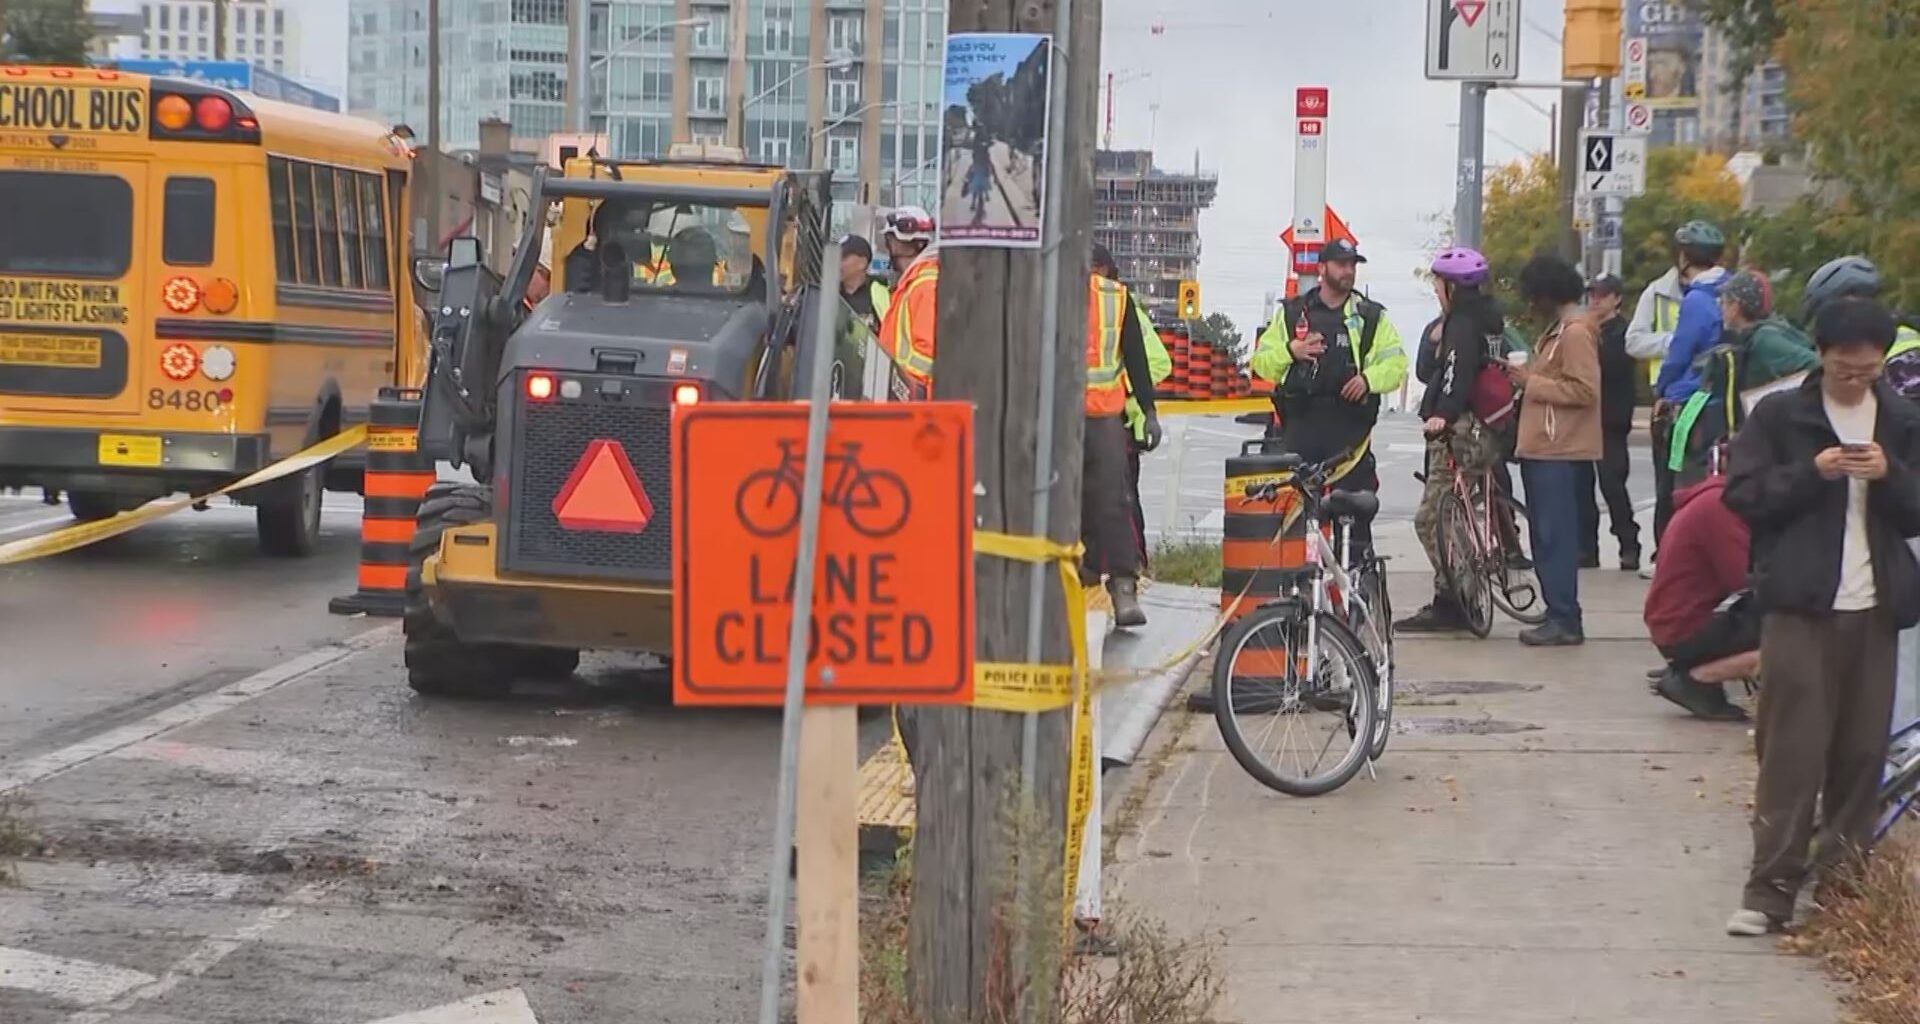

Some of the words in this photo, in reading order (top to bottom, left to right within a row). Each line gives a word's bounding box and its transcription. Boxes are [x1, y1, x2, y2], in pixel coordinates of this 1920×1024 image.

[89, 88, 142, 132] BUS
[1302, 122, 1319, 133] 149
[0, 279, 16, 298] DO
[20, 280, 42, 300] NOT
[46, 281, 79, 302] PASS
[82, 284, 119, 304] WHEN
[16, 301, 61, 321] LIGHTS
[64, 303, 129, 324] FLASHING
[148, 387, 222, 412] 8480
[714, 612, 933, 664] CLOSED
[984, 670, 1027, 684] POLICE
[1077, 774, 1086, 794] NOT
